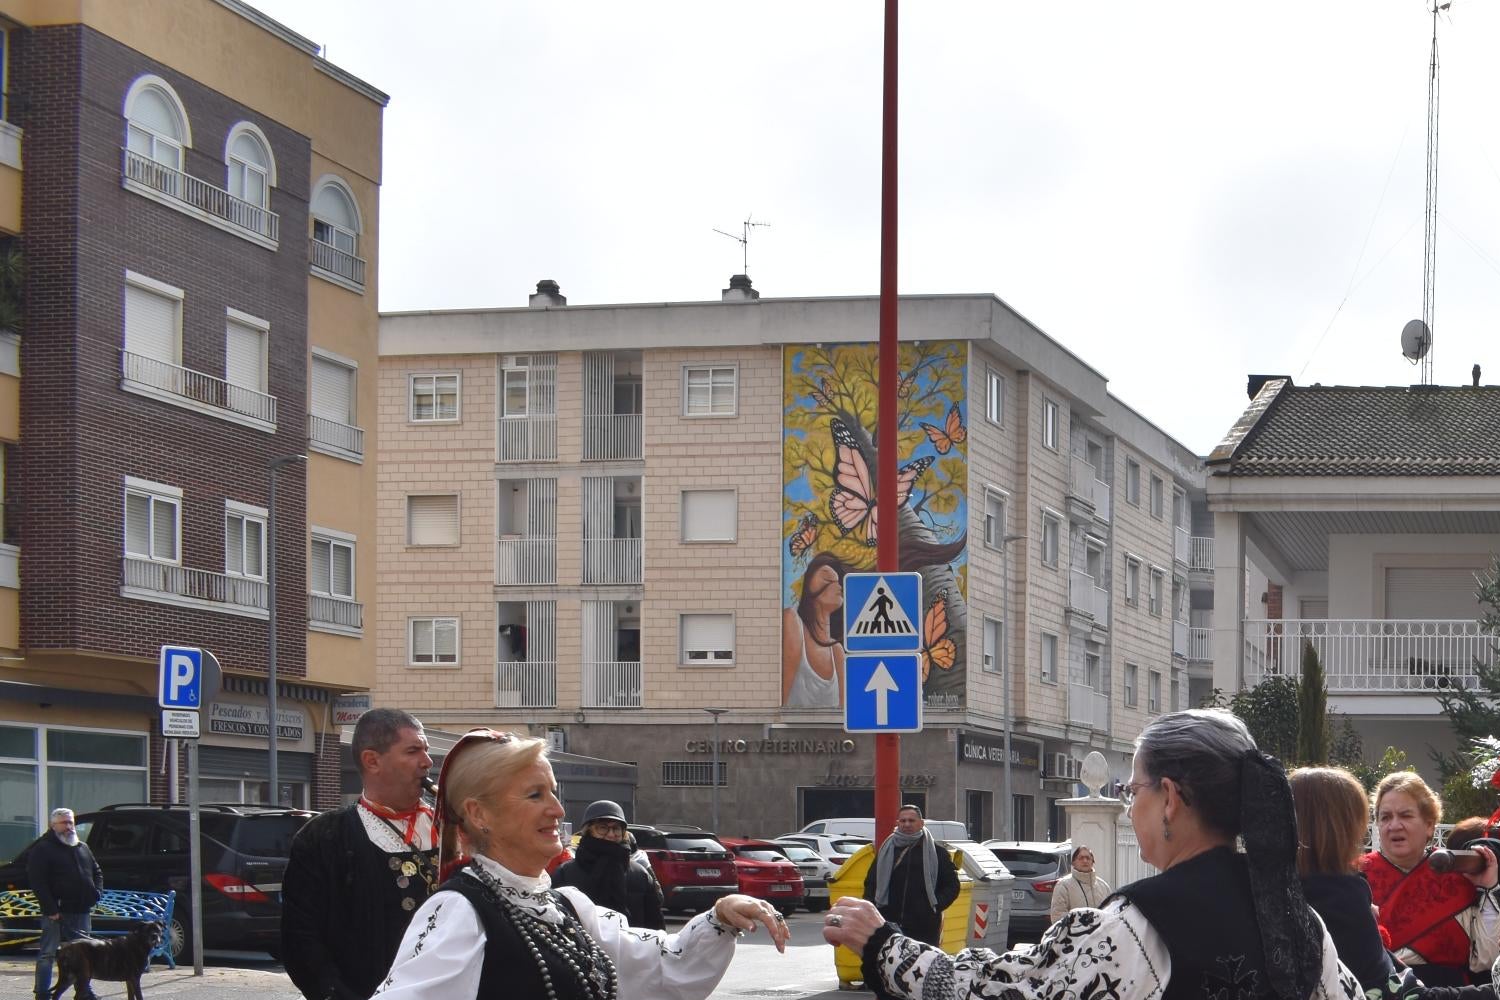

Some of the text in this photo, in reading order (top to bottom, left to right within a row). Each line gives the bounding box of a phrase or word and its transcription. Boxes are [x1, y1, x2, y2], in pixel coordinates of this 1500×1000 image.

[170, 655, 194, 701] P
[212, 703, 252, 719] Pescados
[214, 720, 247, 734] FRESCOS
[254, 724, 302, 738] CONLADOS
[685, 739, 855, 754] CENTRO VETERINARIO
